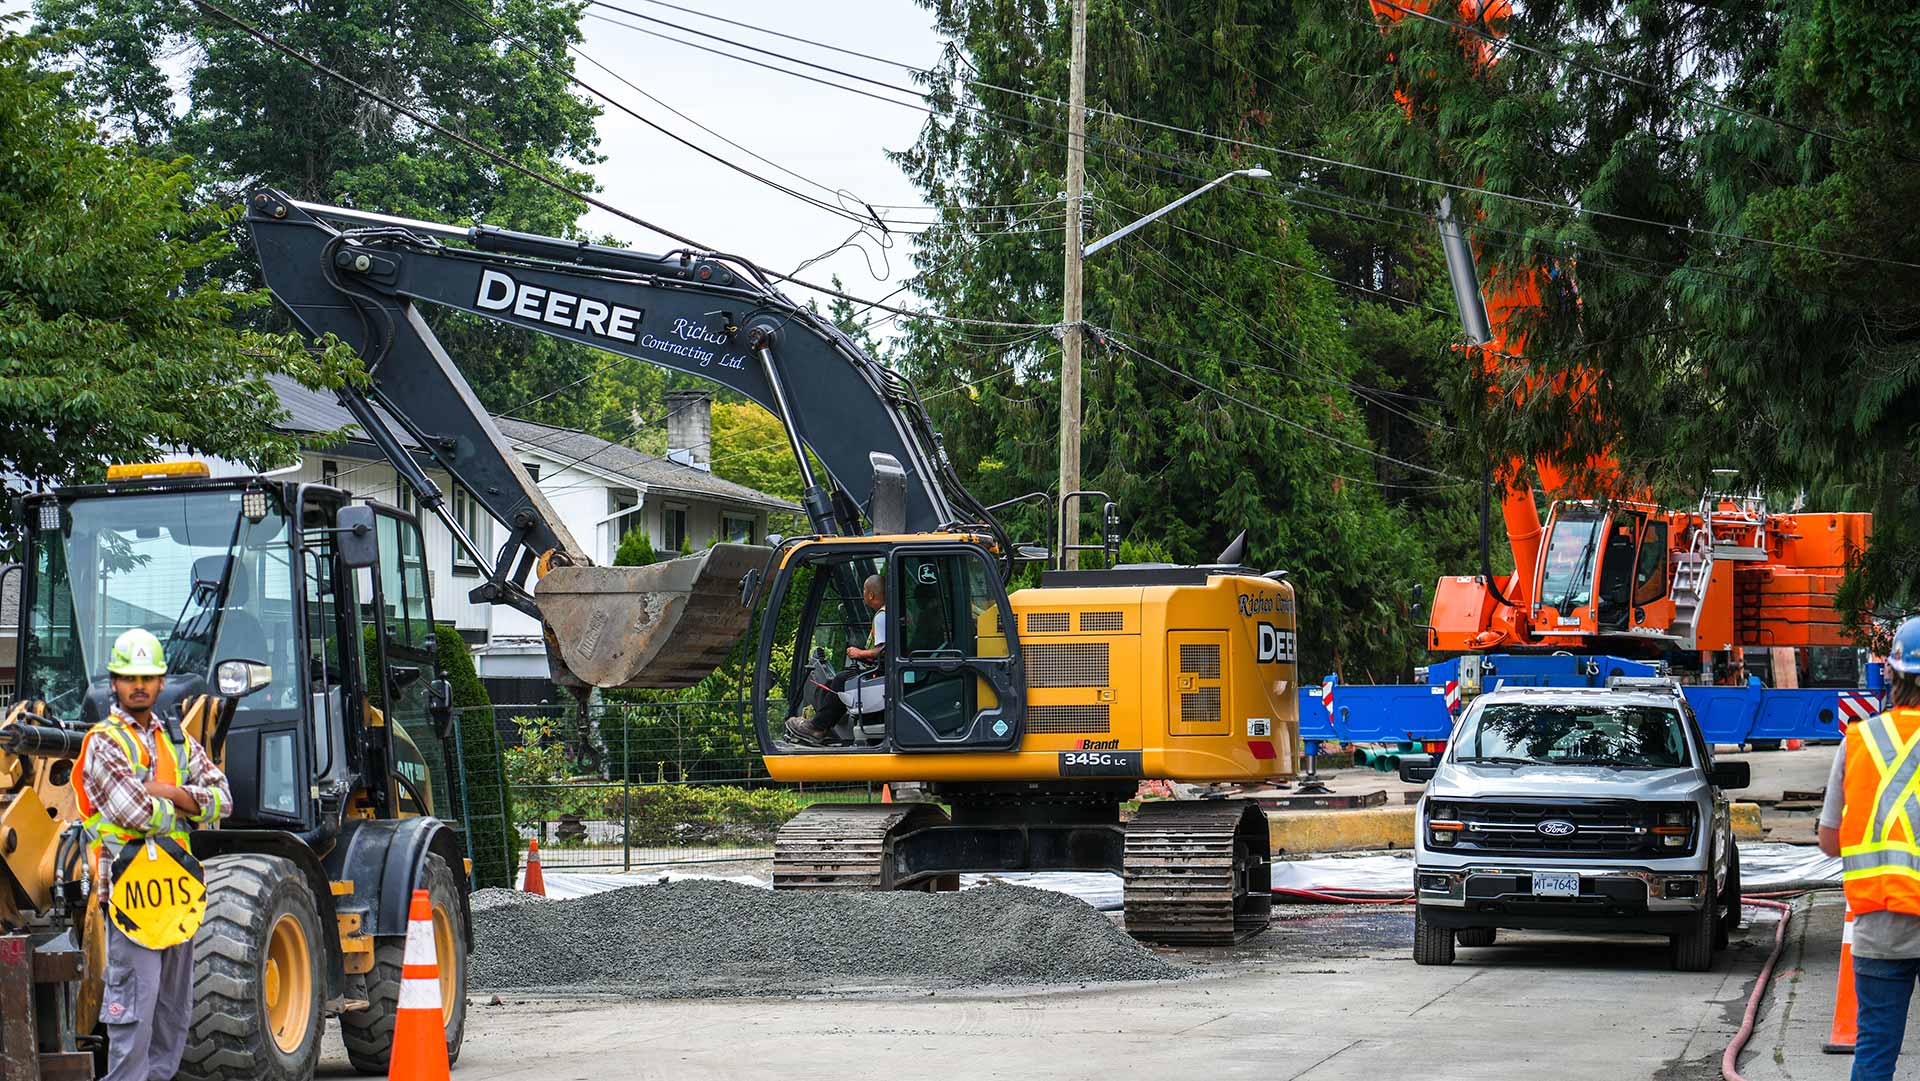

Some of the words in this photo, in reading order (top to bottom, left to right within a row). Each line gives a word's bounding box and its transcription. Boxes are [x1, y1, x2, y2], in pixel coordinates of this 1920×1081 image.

[476, 269, 642, 343] DEERE
[641, 334, 714, 367] Contracting
[718, 353, 746, 371] Ltd.
[1238, 590, 1273, 618] Richco
[1258, 624, 1297, 661] DEE
[1065, 753, 1112, 766] 345G
[1114, 758, 1127, 766] LC
[1083, 739, 1119, 750] Brandt
[1544, 823, 1568, 834] Ford
[125, 876, 192, 910] SLOW
